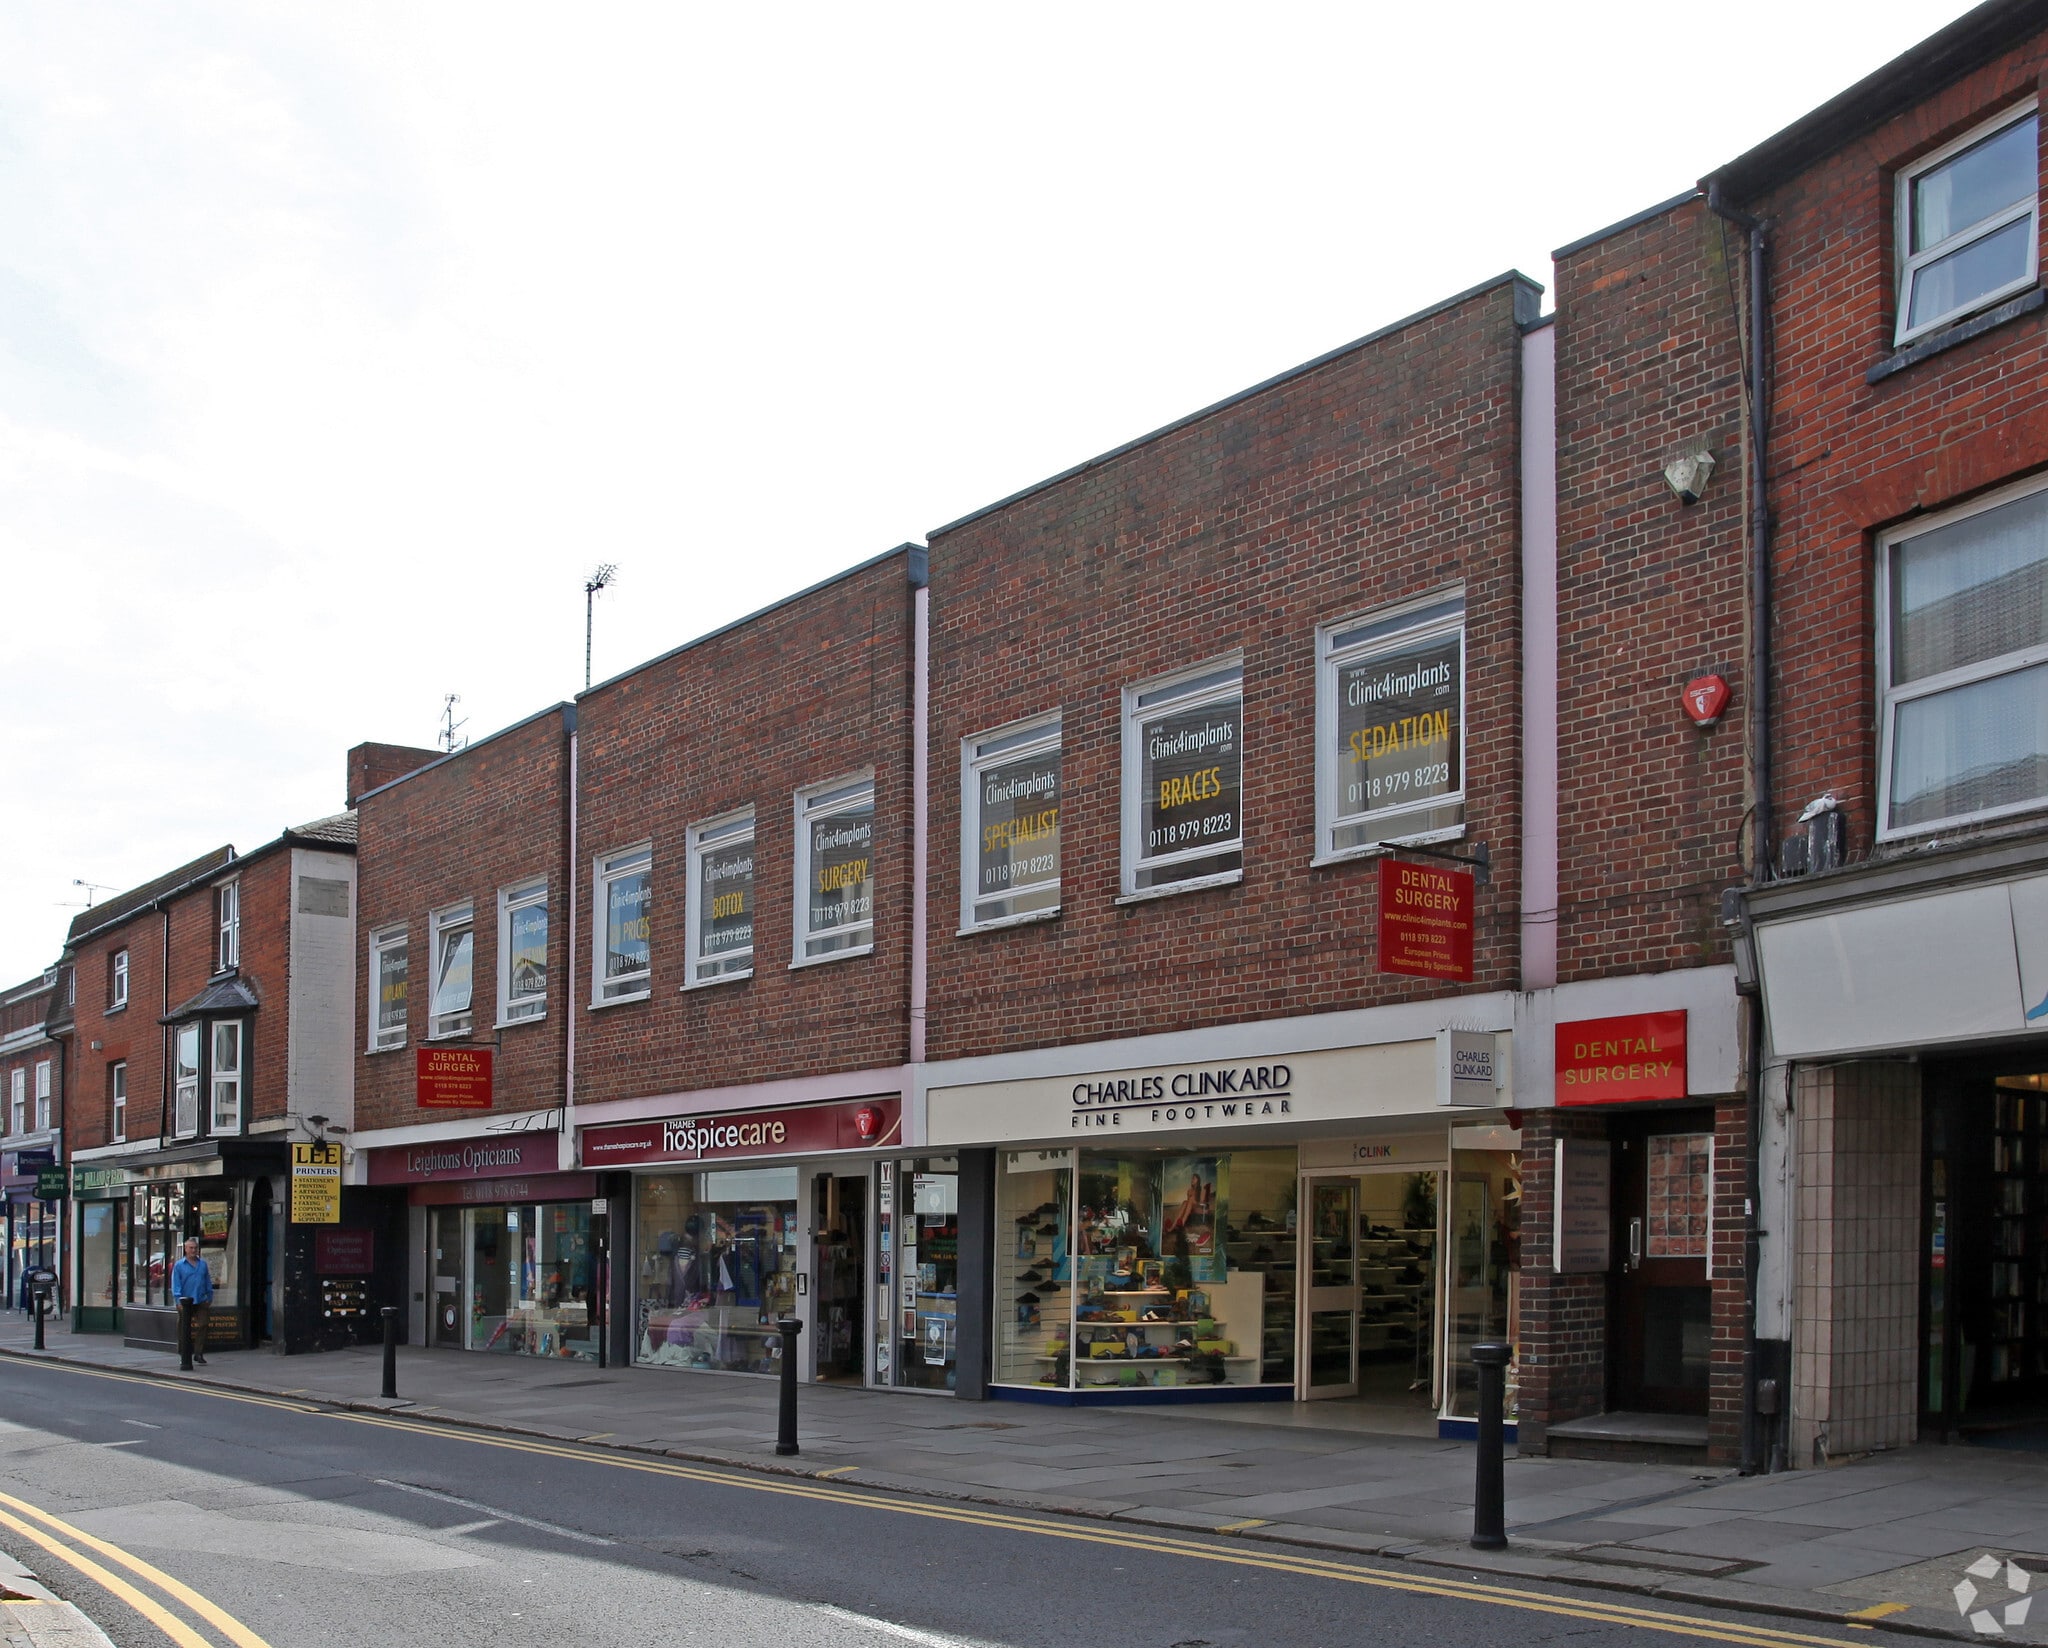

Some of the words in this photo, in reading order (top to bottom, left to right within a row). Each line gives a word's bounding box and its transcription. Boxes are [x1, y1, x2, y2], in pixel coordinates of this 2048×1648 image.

[1348, 661, 1450, 706] Clinic4implants
[1433, 684, 1450, 697] .com
[1149, 722, 1233, 760] Clinic4implants
[1219, 742, 1233, 754] .com
[1350, 708, 1449, 764] SEDATION
[986, 771, 1055, 805] Clinic4implants
[1160, 766, 1220, 810] BRACES
[1348, 778, 1381, 802] 0118
[1385, 771, 1410, 795] 979
[1414, 762, 1449, 788] 8223
[815, 822, 871, 852] Clinic4implants
[984, 808, 1058, 853] SPECIALIST
[1149, 825, 1176, 848] 0118
[1179, 820, 1200, 840] 979
[1203, 812, 1232, 835] 8223
[818, 858, 868, 894] SURGERY
[986, 865, 1008, 884] 0118
[1011, 860, 1028, 879] 979
[1030, 854, 1054, 874] 8223
[1401, 869, 1454, 893] DENTAL
[712, 891, 744, 920] BOTOX
[815, 905, 833, 923] 0118
[834, 901, 849, 918] 979
[850, 896, 870, 914] 8223
[1395, 888, 1460, 911] SURGERY
[624, 916, 650, 941] PRICES
[1384, 911, 1468, 930] www.clinic4implants.com
[704, 932, 721, 948] 0118
[721, 928, 734, 944] 979
[735, 925, 752, 940] 8223
[1400, 932, 1416, 942] 0118
[1418, 933, 1429, 943] 979
[1430, 934, 1446, 944] 8223
[1404, 946, 1432, 958] European
[1432, 950, 1450, 960] Prices
[433, 1052, 476, 1062] DENTAL
[1456, 1050, 1490, 1063] CHARLES
[1574, 1037, 1663, 1059] DENTAL
[428, 1062, 481, 1072] SURGERY
[1453, 1063, 1493, 1076] CLINKARD
[1565, 1061, 1673, 1085] SURGERY
[1072, 1076, 1164, 1105] CHARLES
[1171, 1064, 1291, 1096] CLINKARD
[669, 1120, 696, 1129] THAMES
[1071, 1112, 1121, 1127] FINE
[1151, 1100, 1291, 1122] FOOTWEAR
[663, 1120, 786, 1158] hospicecare
[1359, 1145, 1392, 1158] CLINK
[296, 1146, 337, 1164] LEE
[407, 1151, 461, 1177] Leightons
[463, 1144, 521, 1174] Opticians
